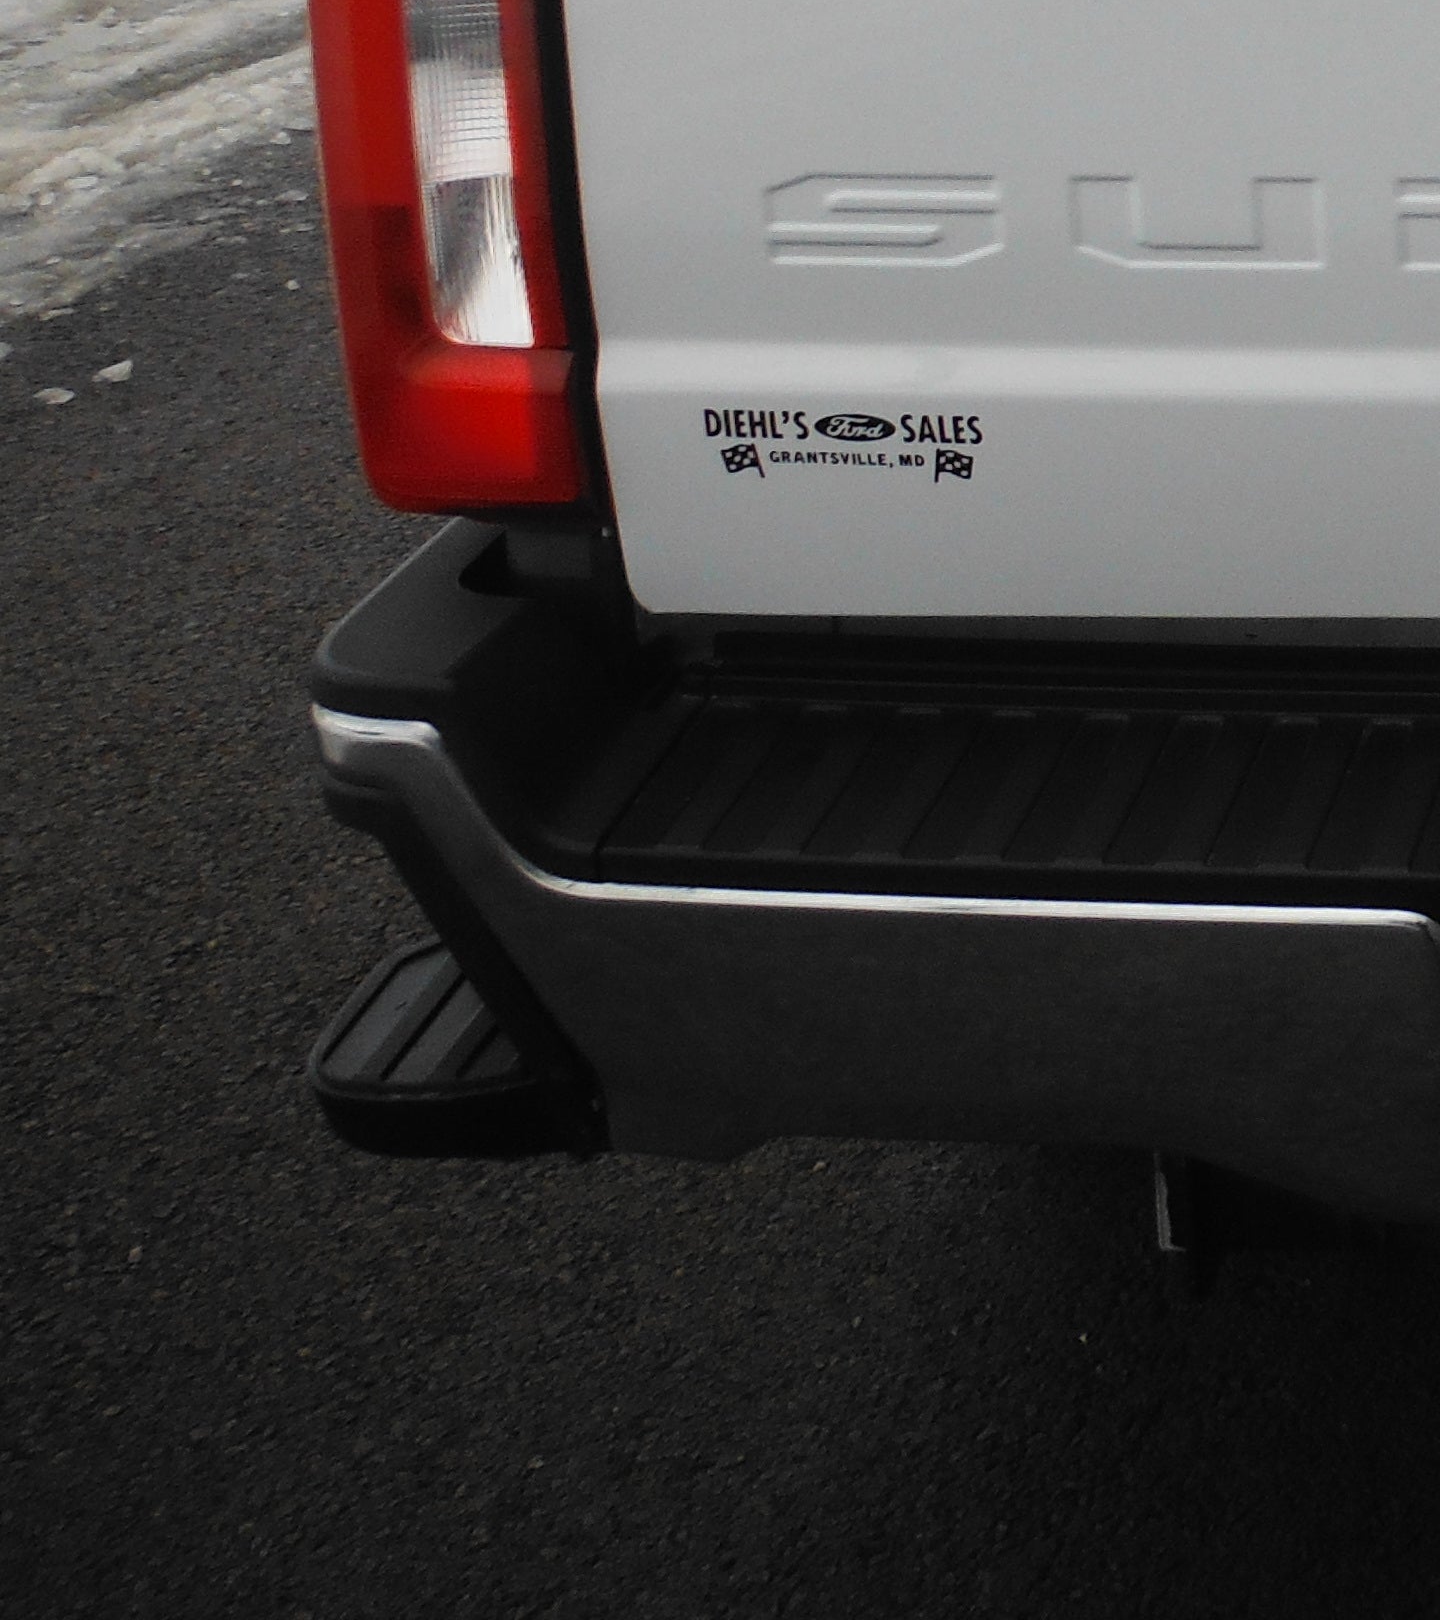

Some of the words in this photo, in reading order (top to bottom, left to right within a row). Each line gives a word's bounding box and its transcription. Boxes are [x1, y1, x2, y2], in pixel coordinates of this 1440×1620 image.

[704, 408, 810, 440] DIEHL'S
[825, 415, 884, 438] Ford
[901, 414, 983, 444] SALES
[769, 450, 894, 468] GRANTSVILLE,
[898, 454, 926, 467] MD
